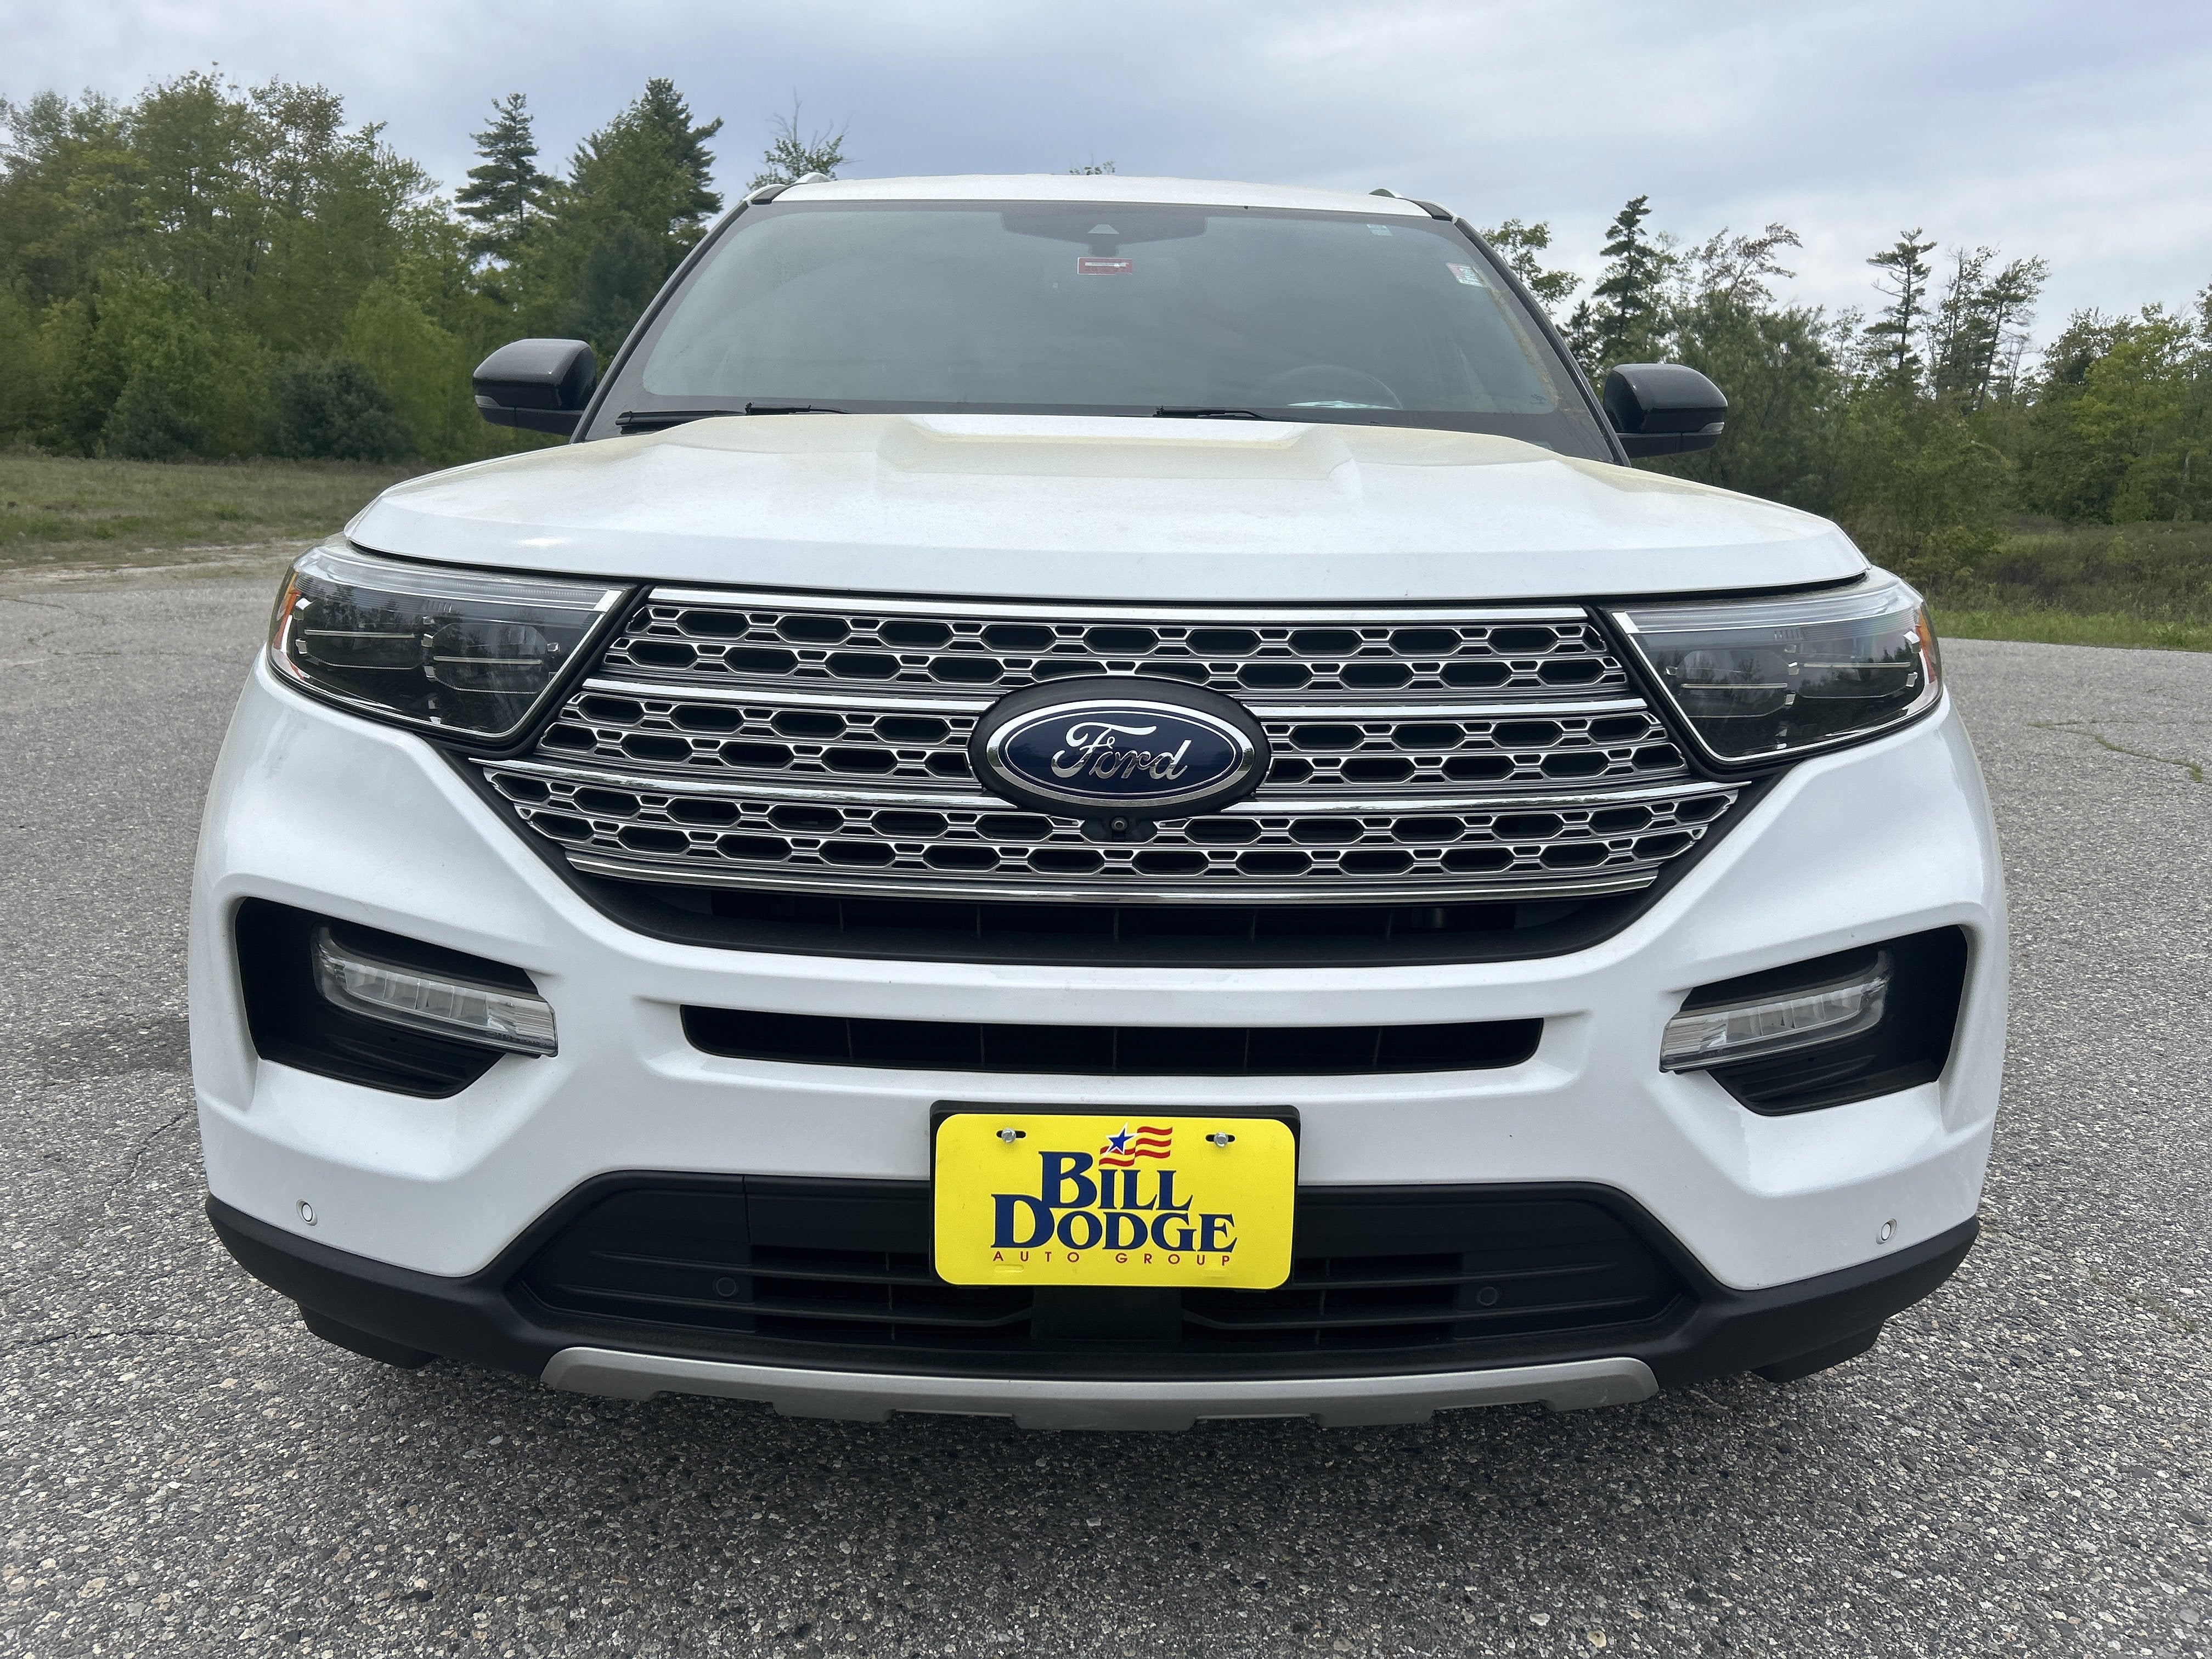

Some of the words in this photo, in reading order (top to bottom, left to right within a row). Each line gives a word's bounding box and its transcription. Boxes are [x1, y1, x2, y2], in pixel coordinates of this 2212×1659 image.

[1051, 721, 1192, 780] Ford
[1039, 1151, 1193, 1211] BILL
[990, 1194, 1238, 1253] DODGE
[992, 1251, 1080, 1263] AUTO
[1115, 1252, 1230, 1267] GROUP
